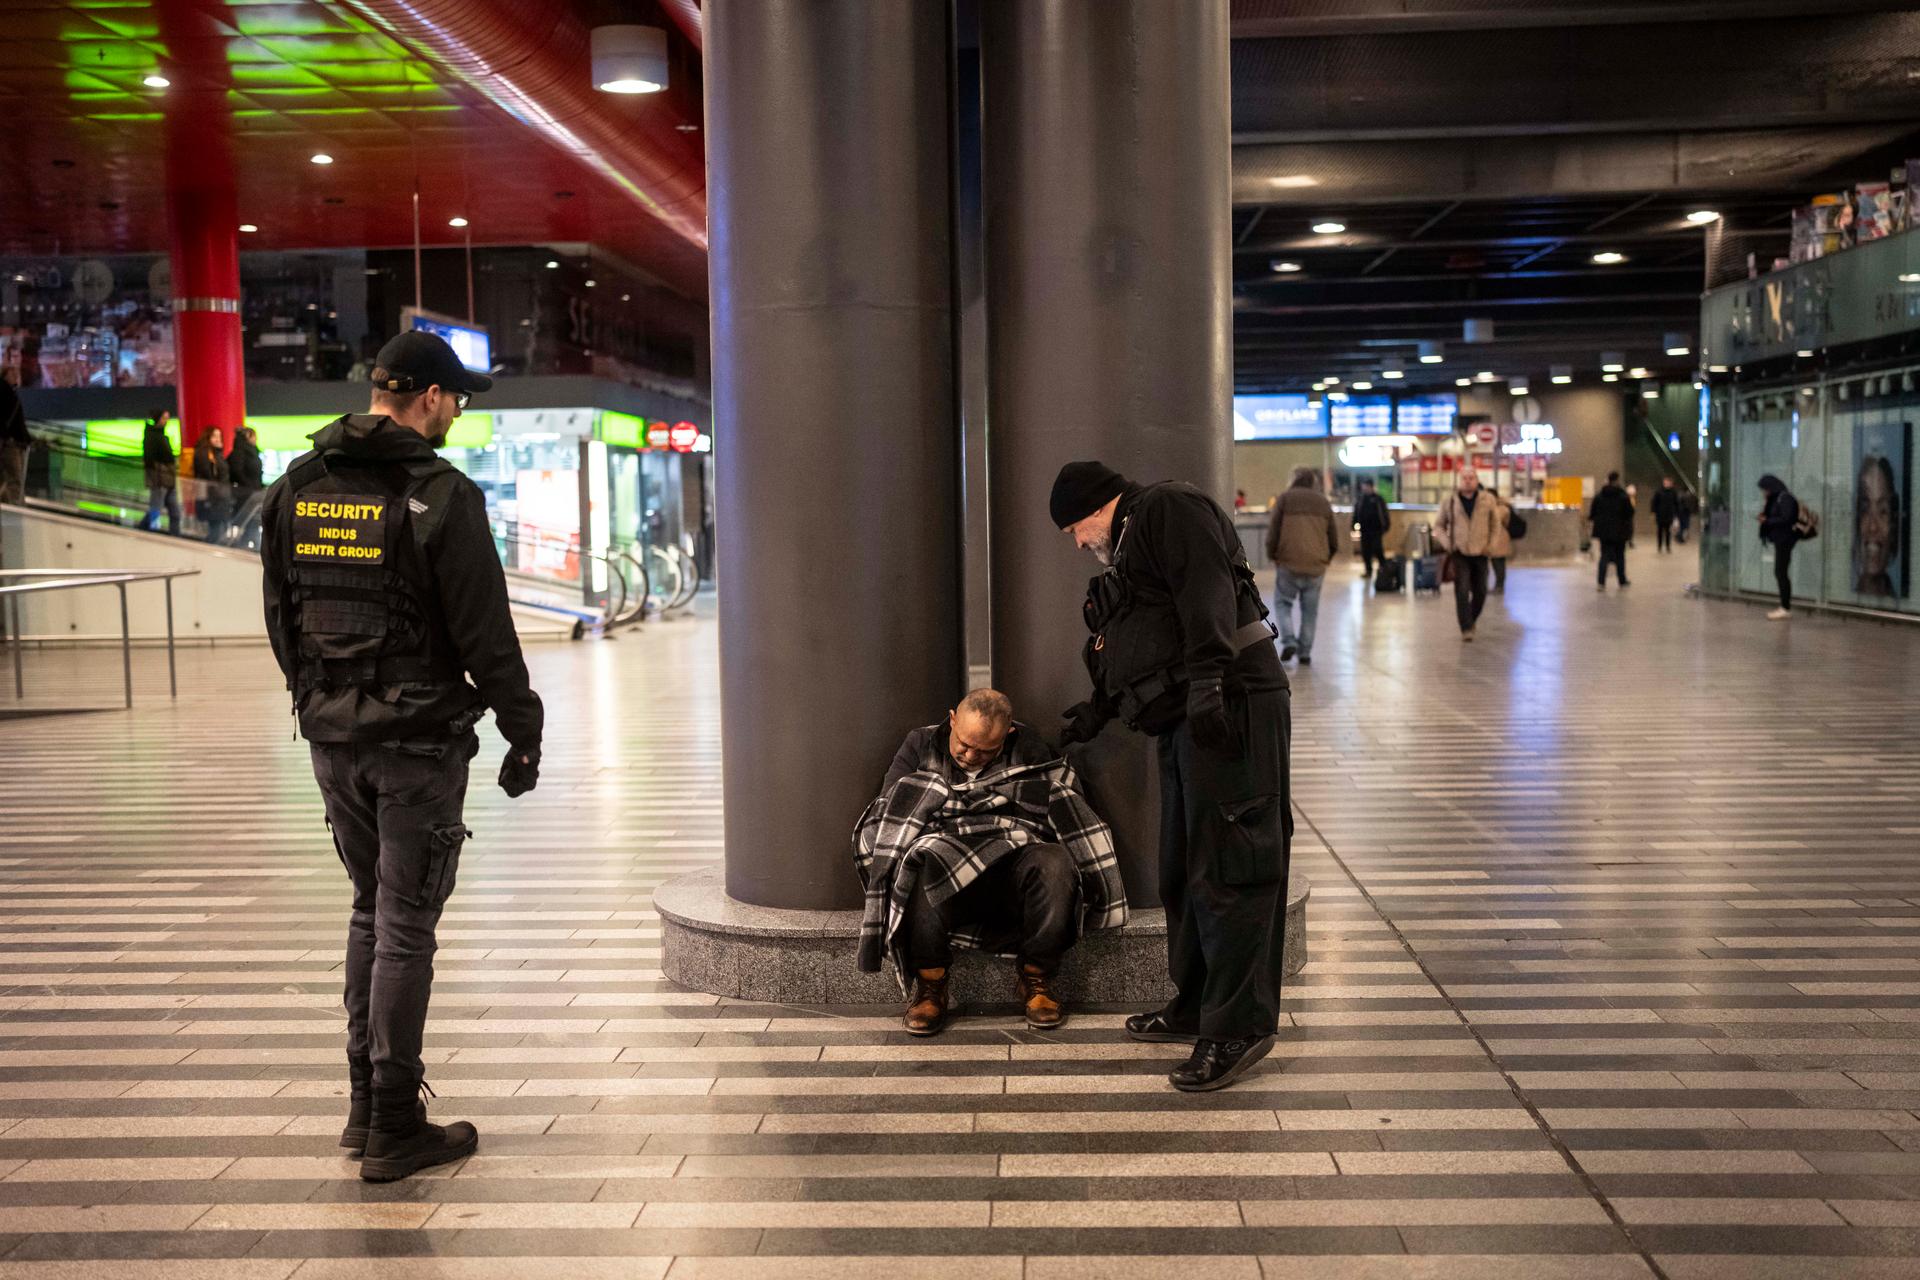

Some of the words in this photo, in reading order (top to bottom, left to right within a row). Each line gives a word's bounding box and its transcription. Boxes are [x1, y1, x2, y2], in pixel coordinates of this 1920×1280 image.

[296, 501, 383, 520] SECURITY
[319, 528, 357, 540] INDUS
[296, 544, 335, 556] CENTR
[338, 546, 381, 558] GROUP
